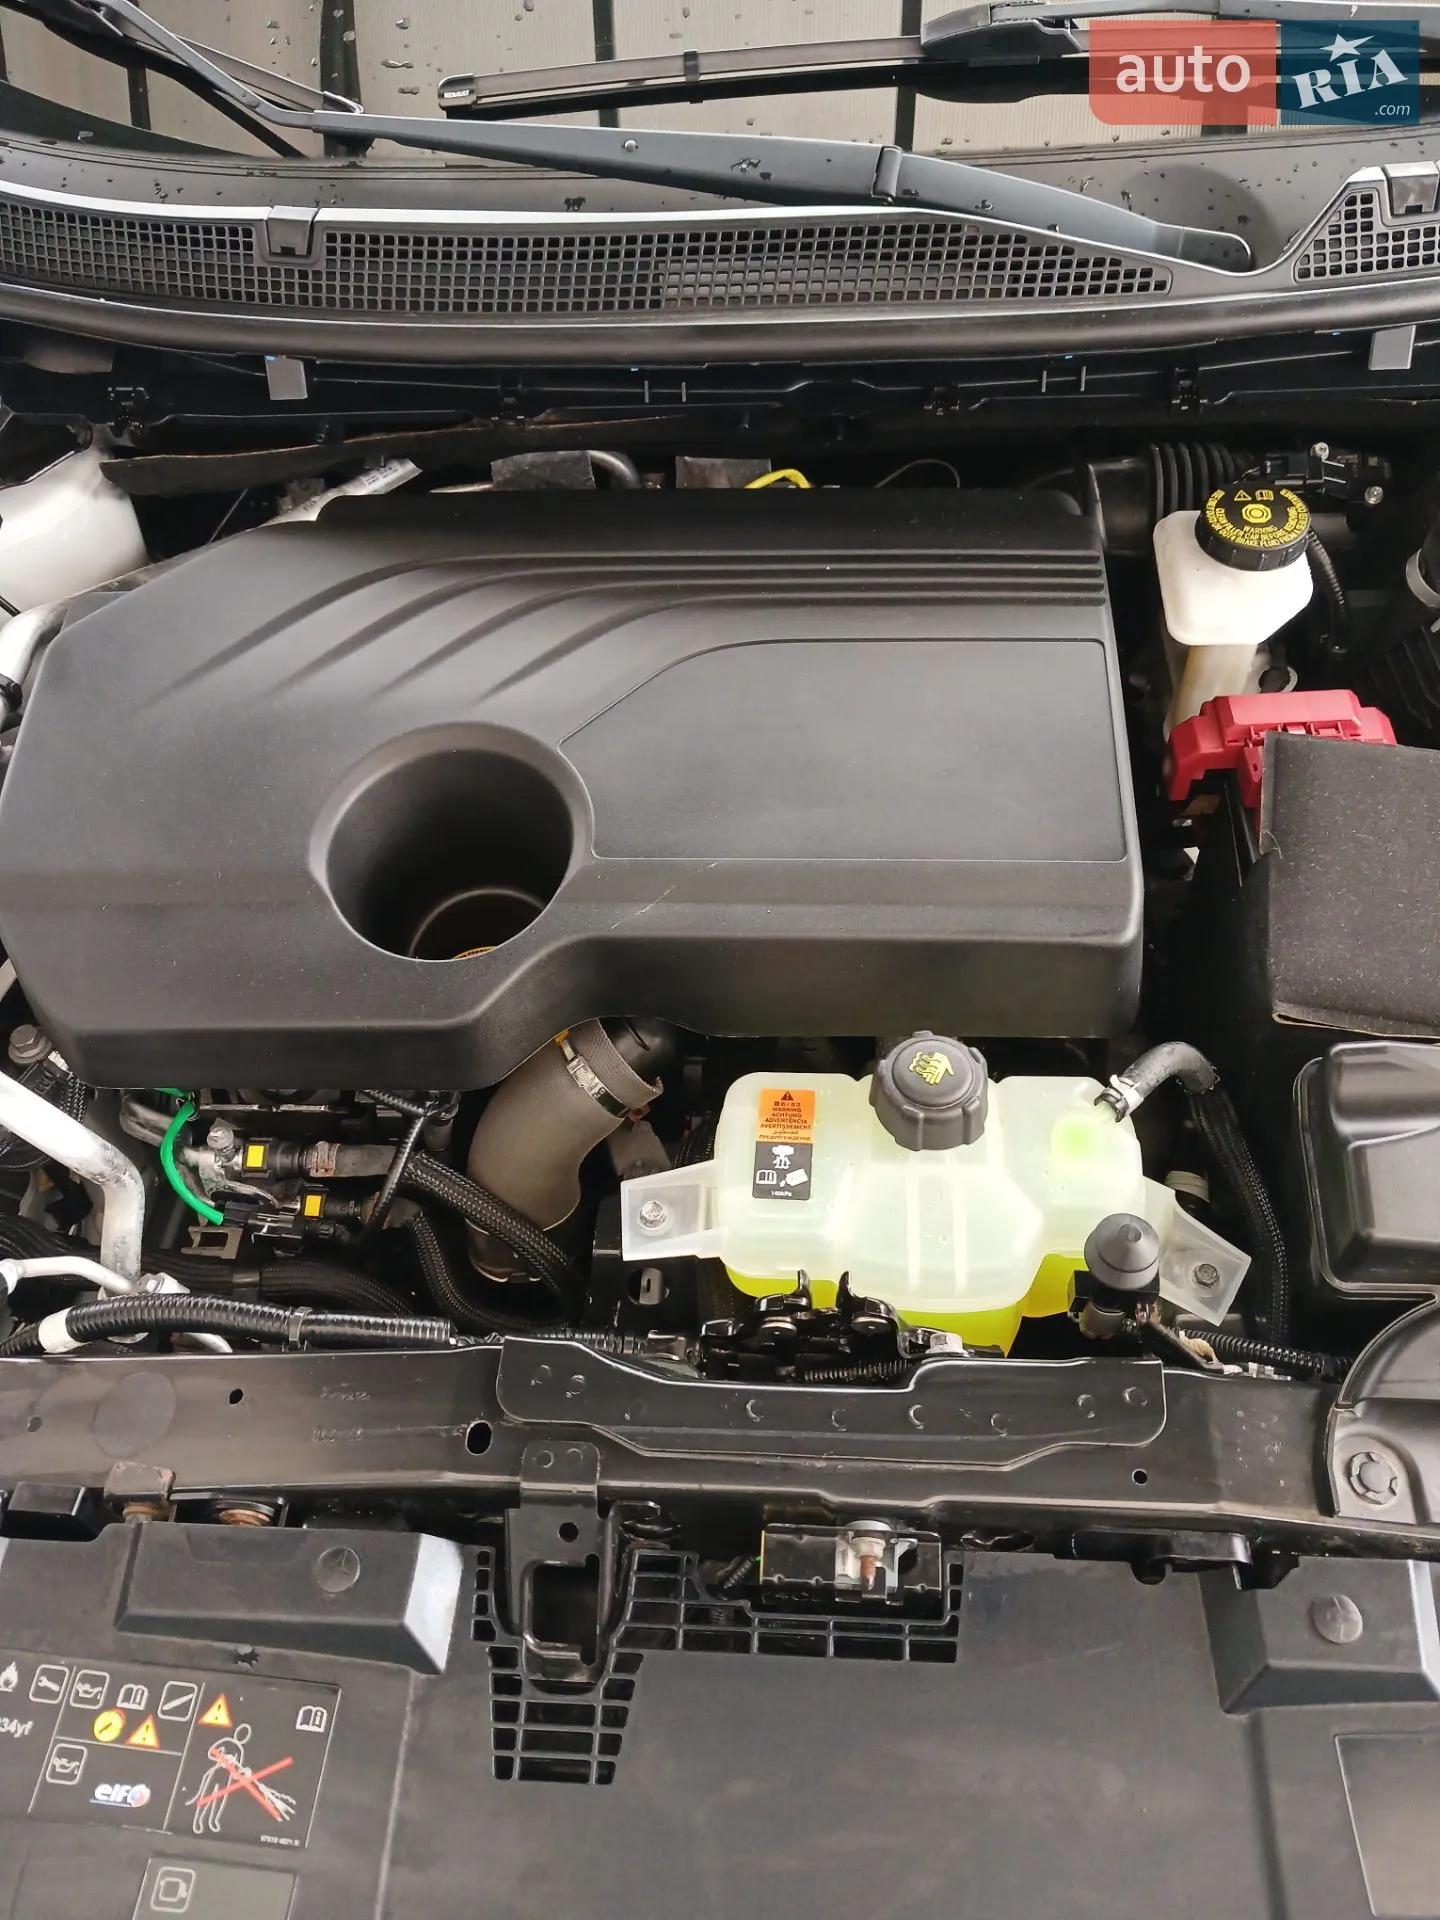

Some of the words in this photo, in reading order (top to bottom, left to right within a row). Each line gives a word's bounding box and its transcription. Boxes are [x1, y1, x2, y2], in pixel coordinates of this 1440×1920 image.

[1217, 528, 1236, 541] DOT4
[1233, 537, 1257, 546] BRAKE
[1259, 538, 1280, 547] FLUID
[1243, 525, 1277, 534] WARNING
[0, 1717, 34, 1738] 34yf
[94, 1783, 132, 1803] elf
